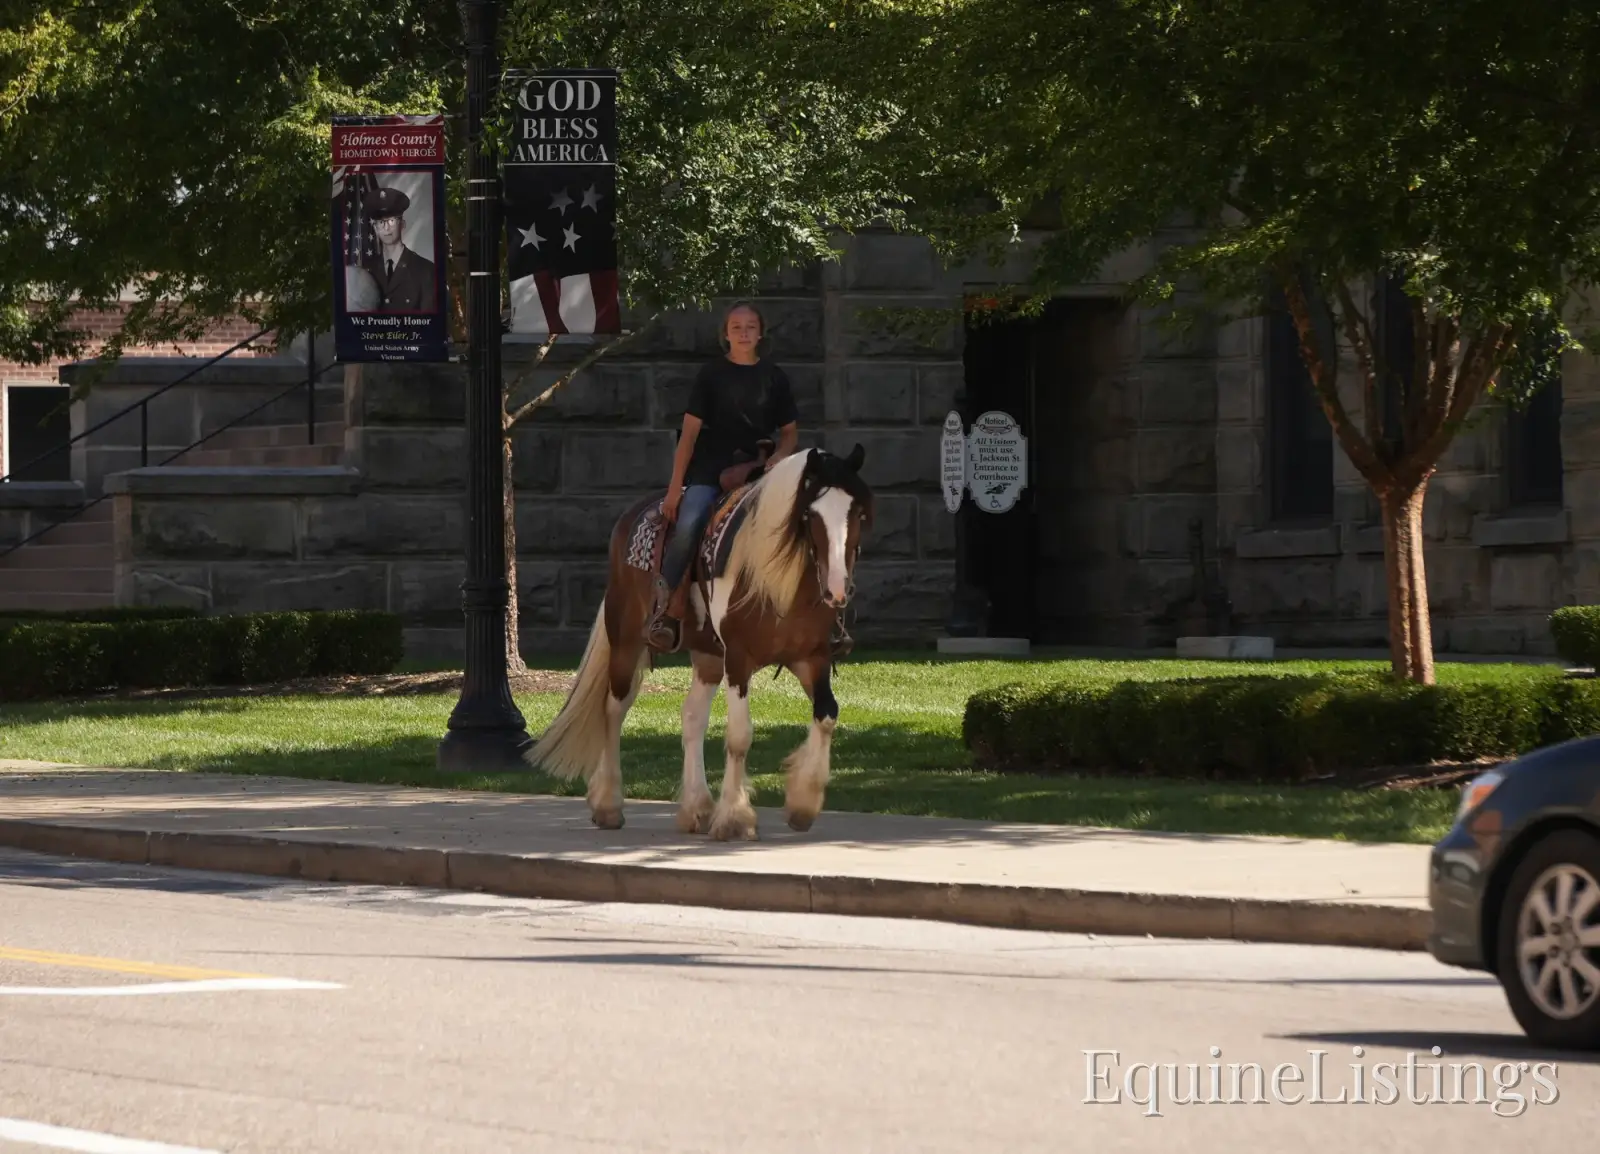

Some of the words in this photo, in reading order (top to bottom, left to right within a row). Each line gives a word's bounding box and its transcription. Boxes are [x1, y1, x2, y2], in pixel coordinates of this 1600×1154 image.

[518, 79, 601, 112] GOD
[523, 117, 598, 139] BLESS
[340, 132, 387, 146] Holmes
[391, 133, 437, 149] County
[340, 149, 398, 158] HOMETOWN
[401, 148, 437, 157] HEROES
[512, 143, 609, 162] AMERICA
[351, 317, 365, 326] We
[367, 316, 402, 327] Proudly
[404, 316, 432, 326] Honor
[361, 332, 384, 340] Steve
[984, 417, 1008, 425] Notice!
[989, 437, 1017, 445] Visitors
[980, 454, 1010, 463] Jackson
[974, 463, 1009, 471] Entrance
[973, 472, 1019, 481] Courthouse
